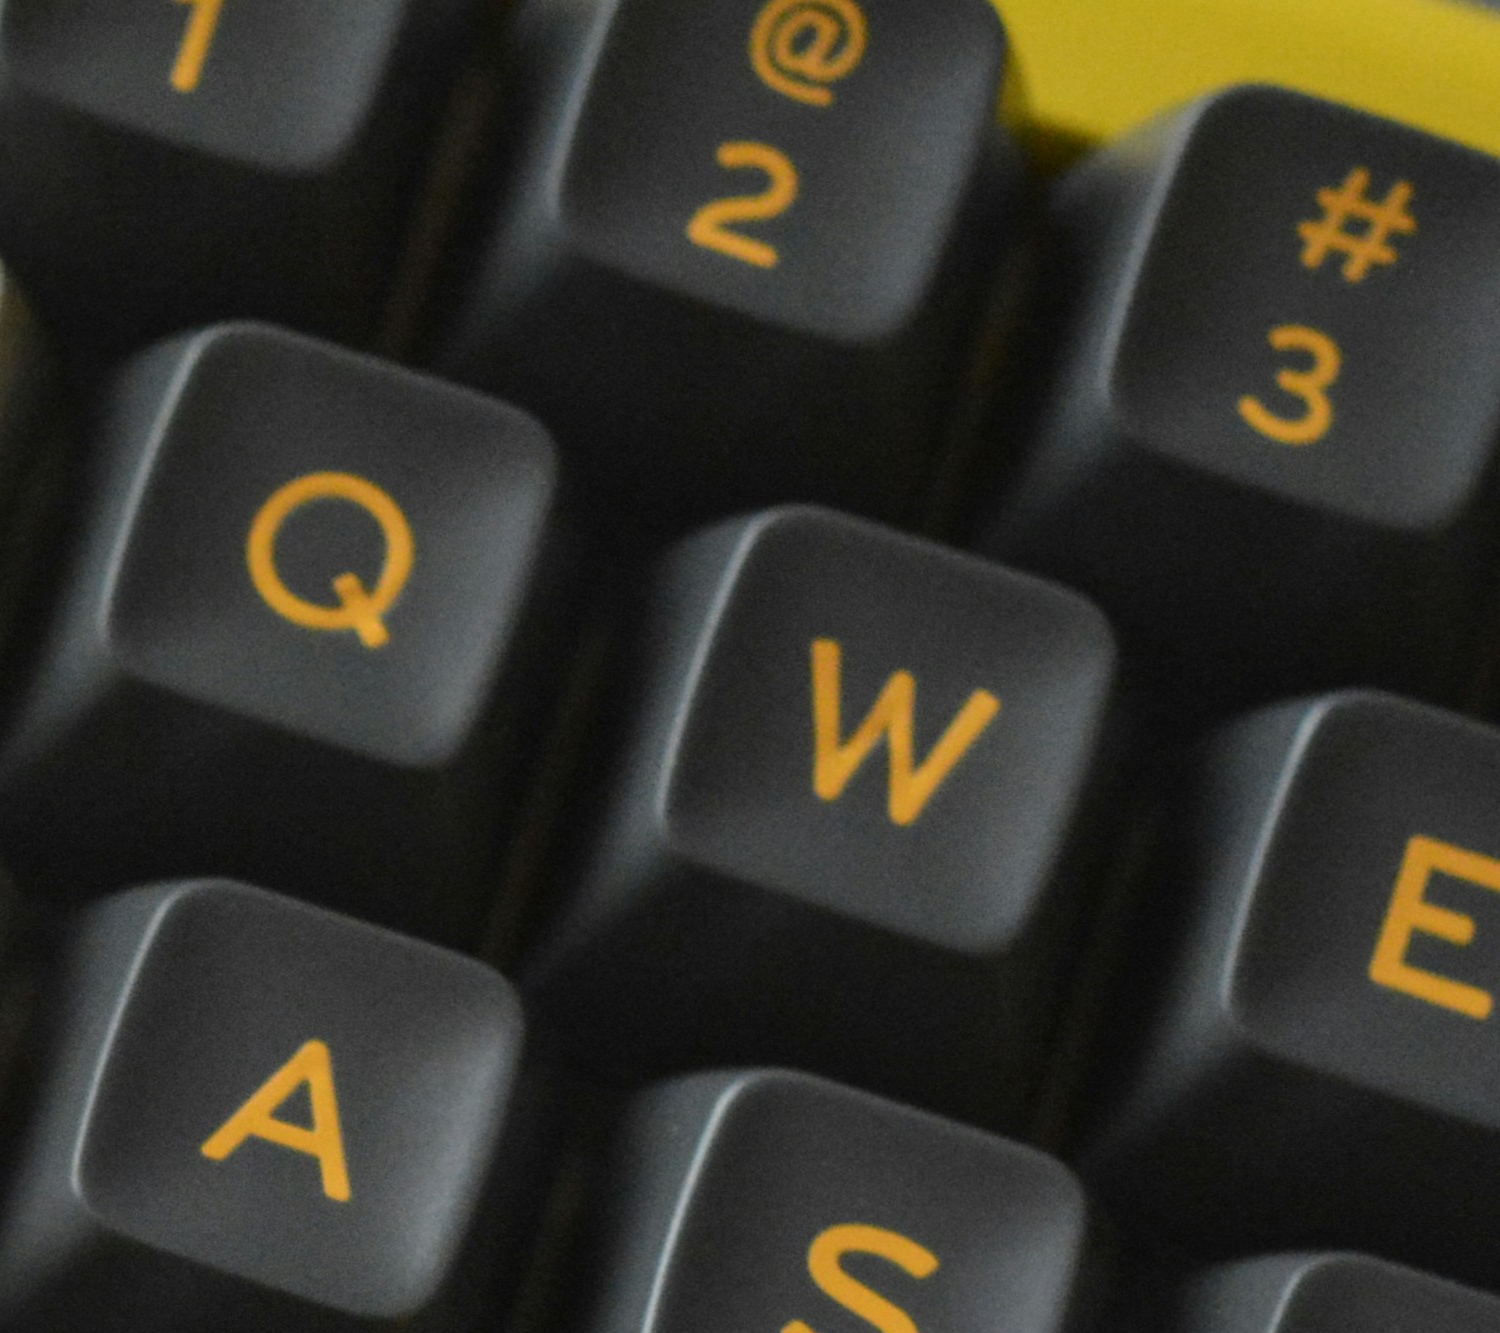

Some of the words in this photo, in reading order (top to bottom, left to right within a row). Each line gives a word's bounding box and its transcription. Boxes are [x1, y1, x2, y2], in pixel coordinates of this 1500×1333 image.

[750, 0, 866, 107] @
[687, 141, 799, 268] 2
[1298, 169, 1415, 282] #
[1237, 326, 1342, 445] 3
[245, 471, 415, 649] Q
[811, 638, 1001, 827] W
[1367, 835, 1500, 1020] E
[200, 1038, 352, 1203] A
